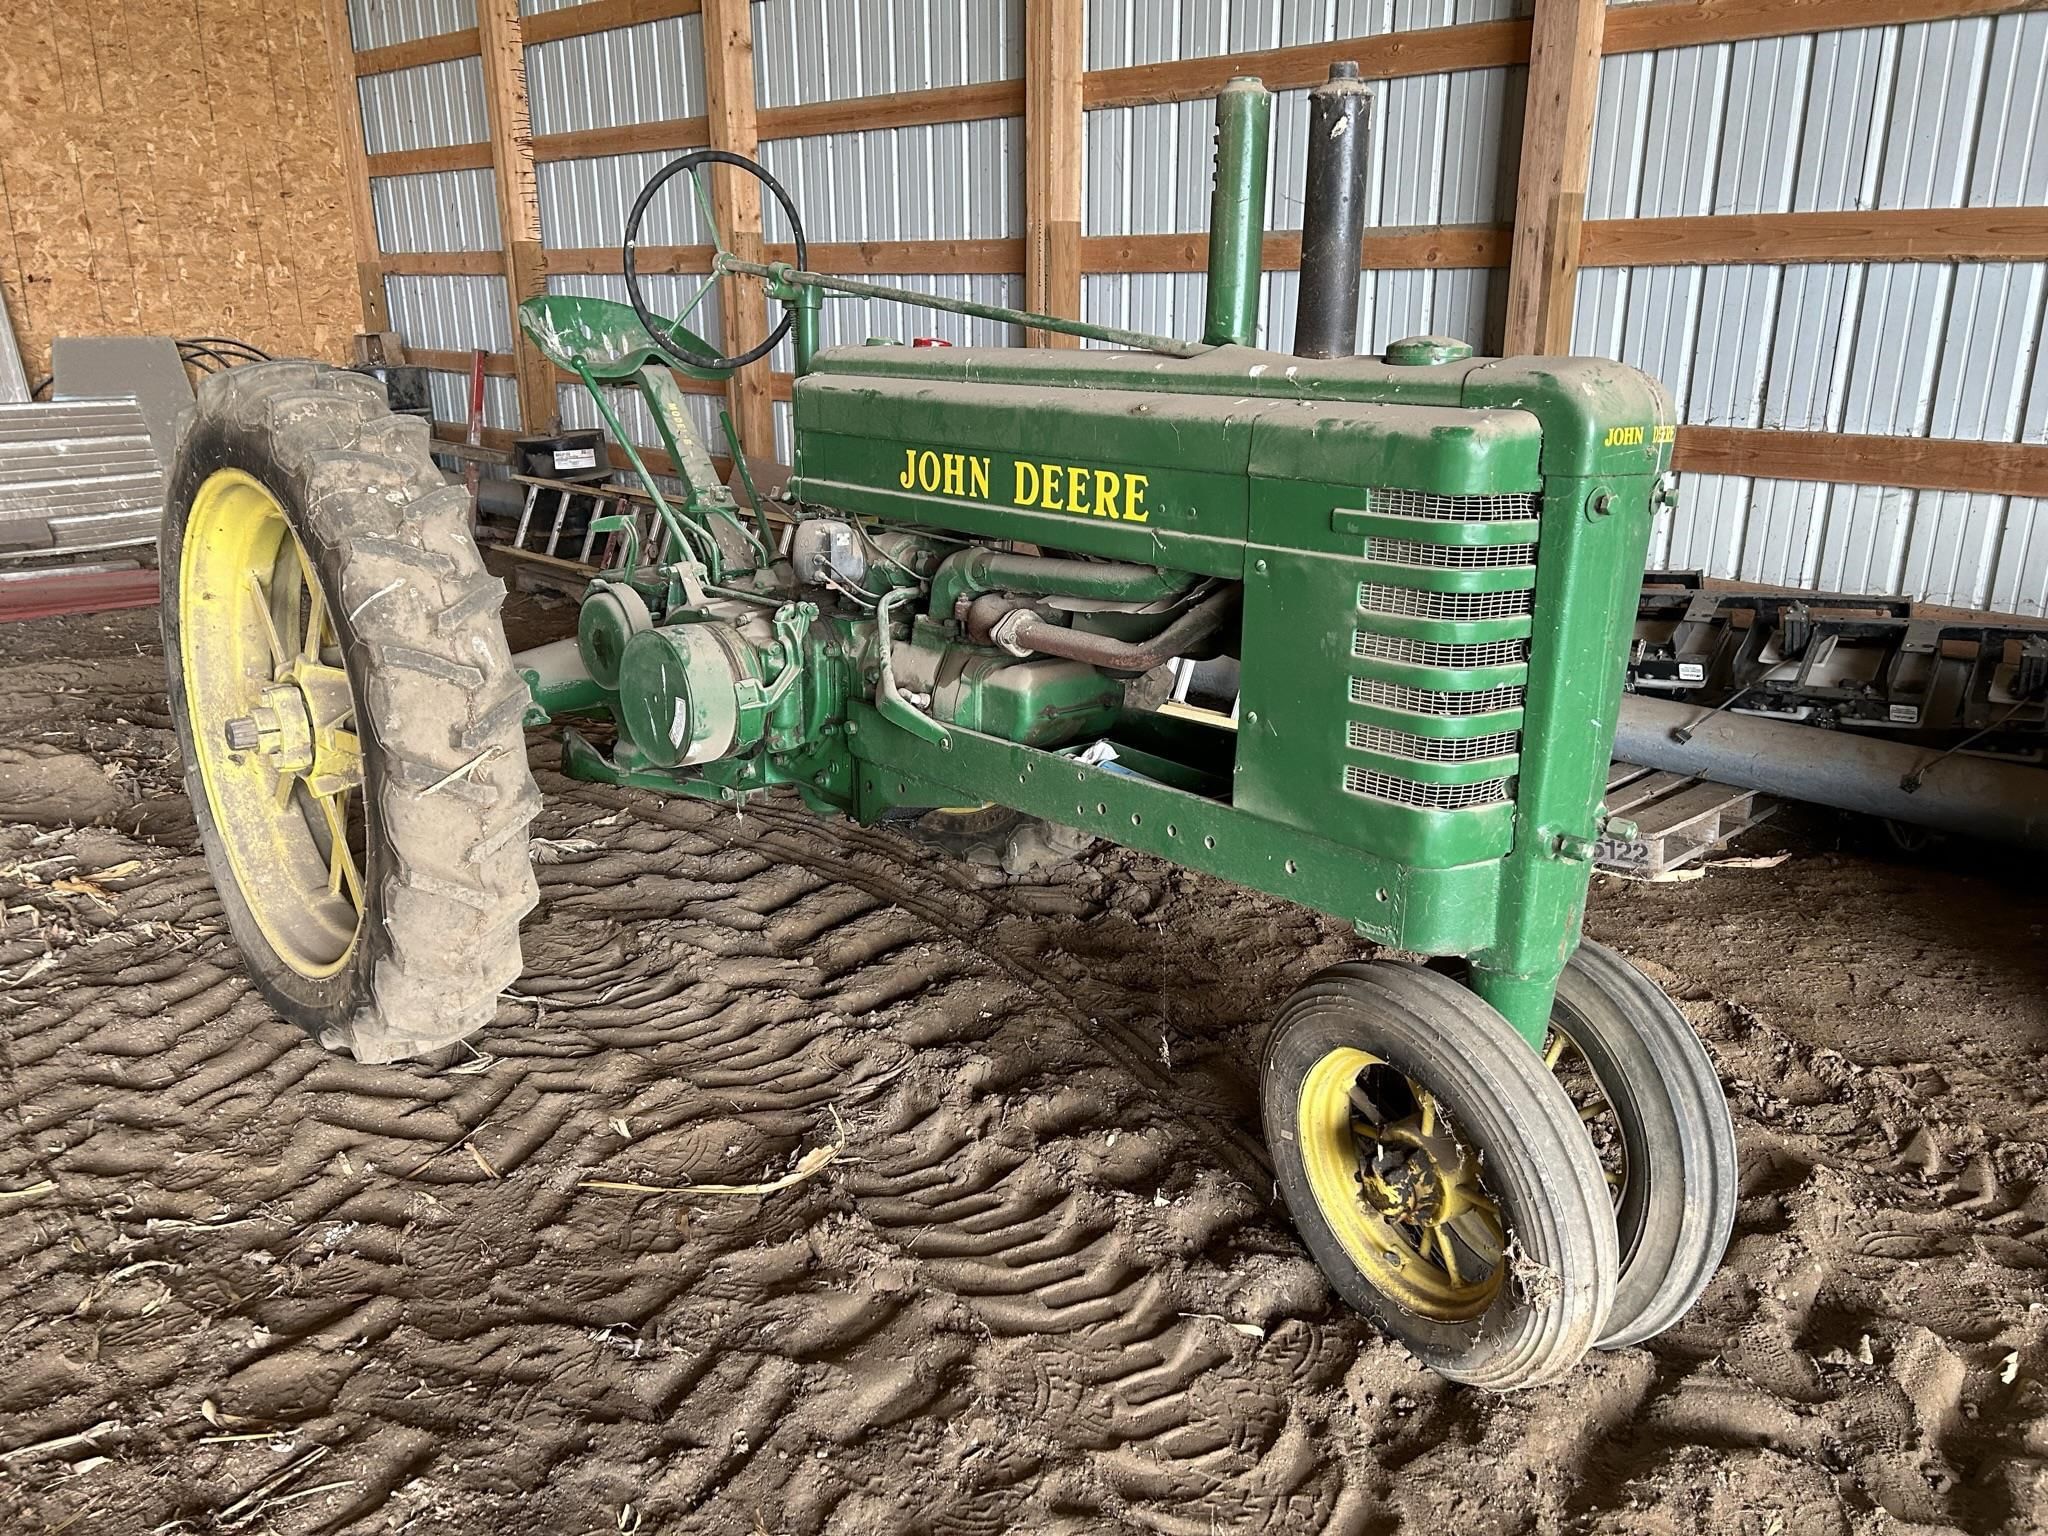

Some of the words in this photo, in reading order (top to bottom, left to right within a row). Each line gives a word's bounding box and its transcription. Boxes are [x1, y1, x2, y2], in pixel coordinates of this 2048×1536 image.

[1604, 426, 1645, 447] JOHN
[900, 449, 990, 499] JOHN
[1014, 461, 1150, 522] DEERE
